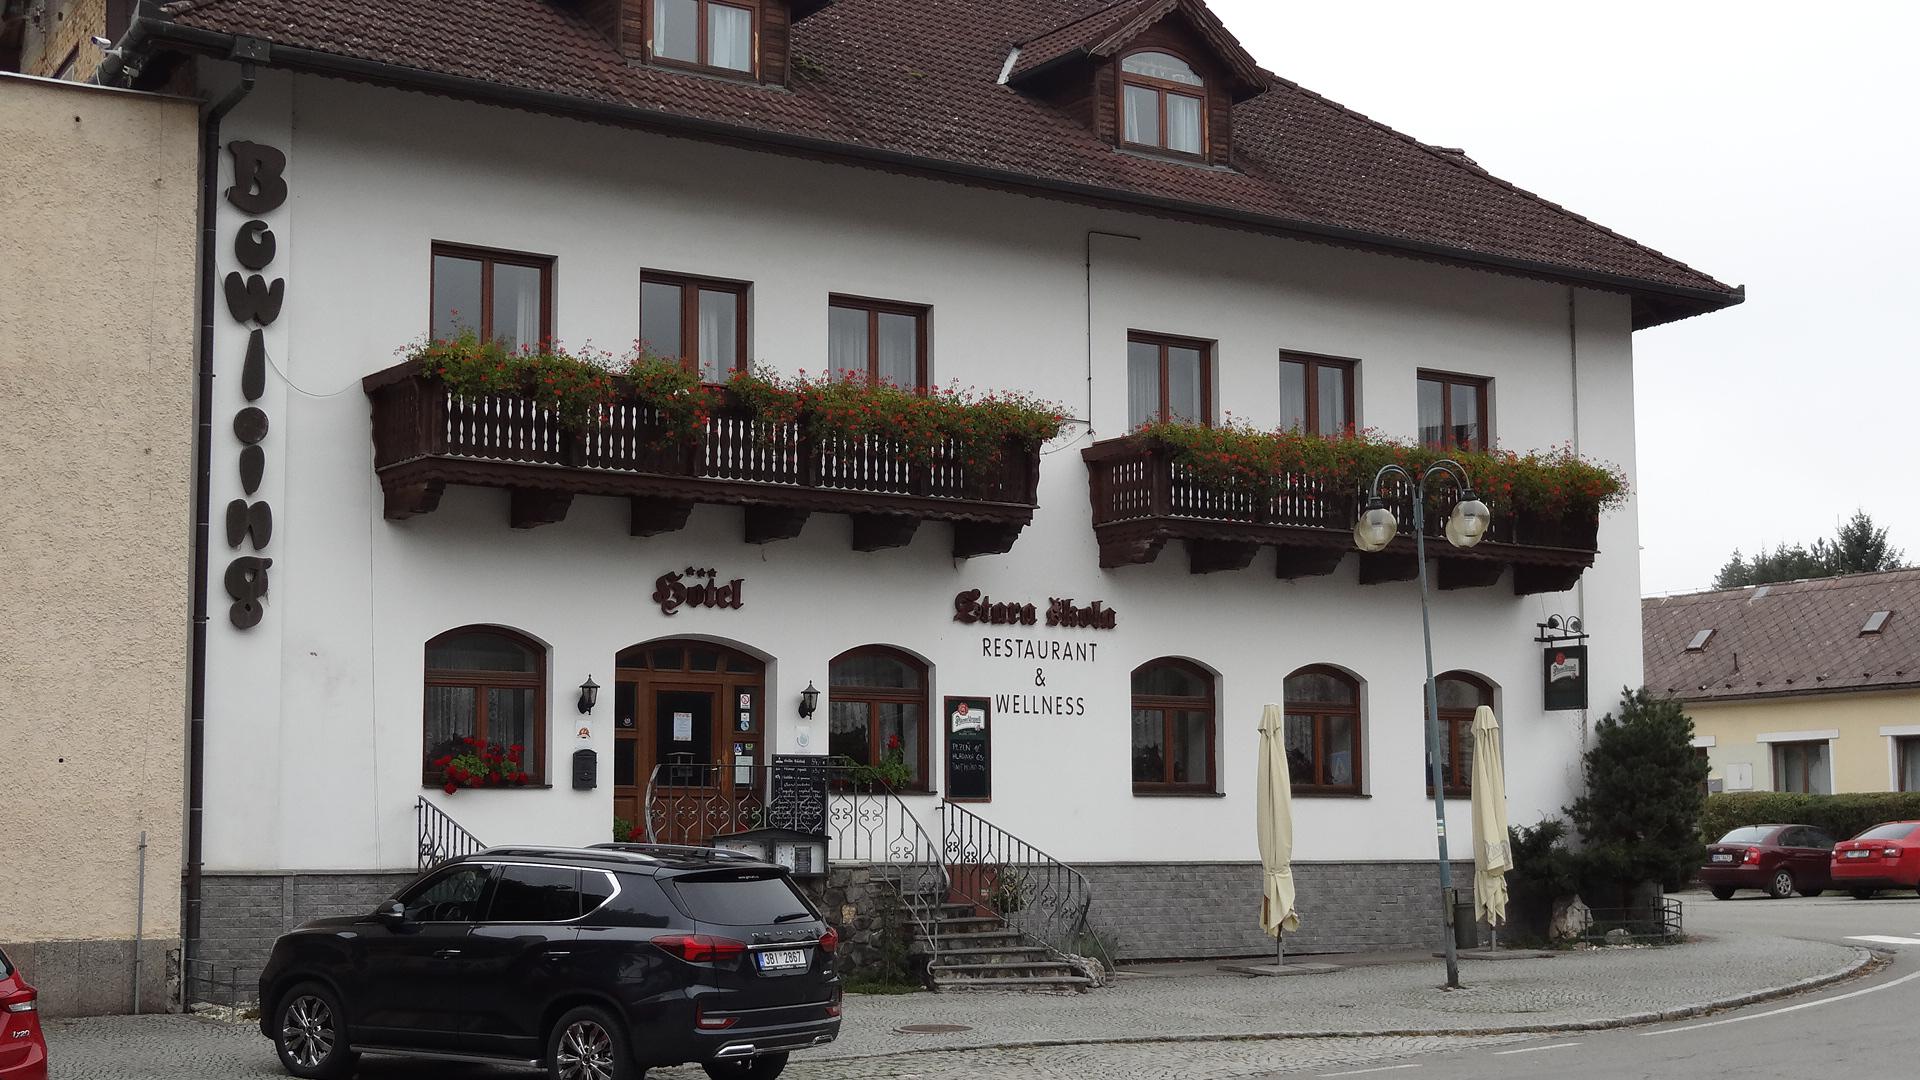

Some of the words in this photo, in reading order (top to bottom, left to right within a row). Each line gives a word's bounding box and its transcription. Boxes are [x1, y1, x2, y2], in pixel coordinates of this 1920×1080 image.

[653, 571, 745, 615] Hotel
[982, 637, 1098, 662] RESTAURANT
[1035, 667, 1046, 687] &
[995, 694, 1085, 716] WELLNESS
[784, 952, 801, 963] 2867
